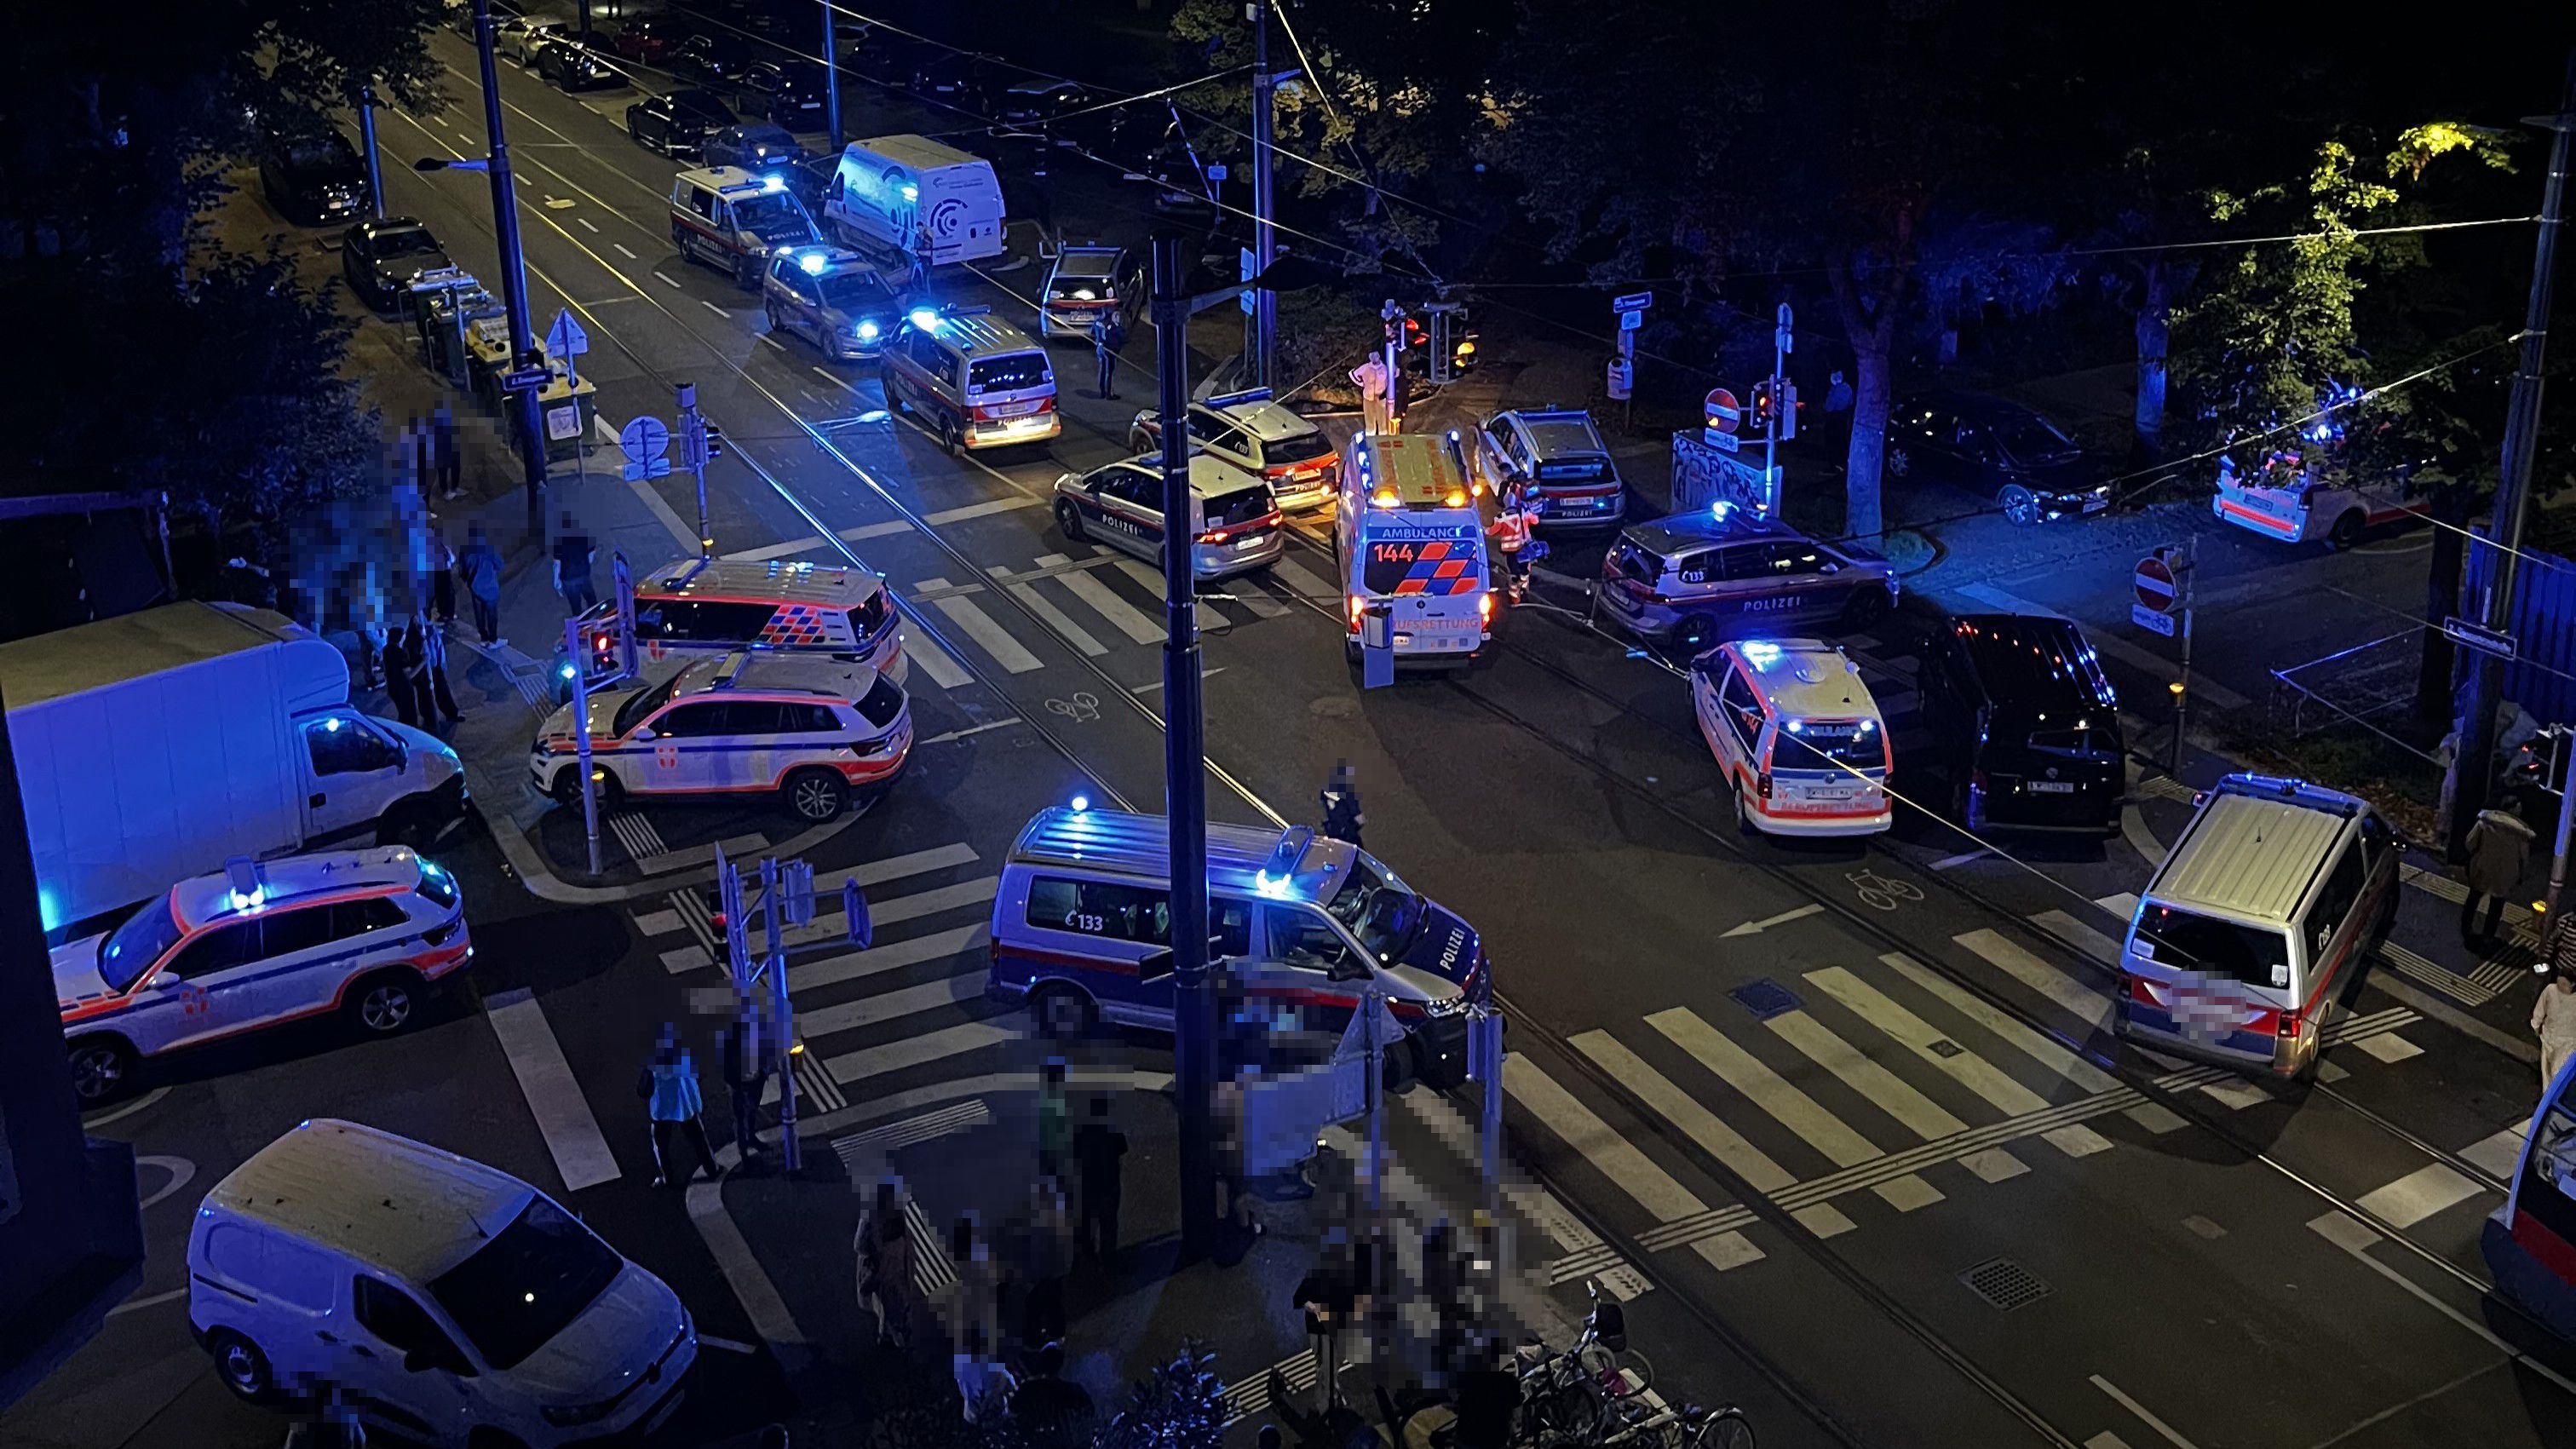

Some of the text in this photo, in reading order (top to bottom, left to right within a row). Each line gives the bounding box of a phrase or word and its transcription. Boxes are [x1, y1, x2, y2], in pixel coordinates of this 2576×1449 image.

[1102, 514, 1138, 536] POLIZEI
[1382, 526, 1463, 538] AMBULANCE
[1373, 543, 1414, 562] 144
[1744, 595, 1801, 612] POLIZEI
[1393, 618, 1479, 630] RUFSRETTUNG
[1077, 913, 1103, 931] 133
[1439, 927, 1465, 971] POLIZEI
